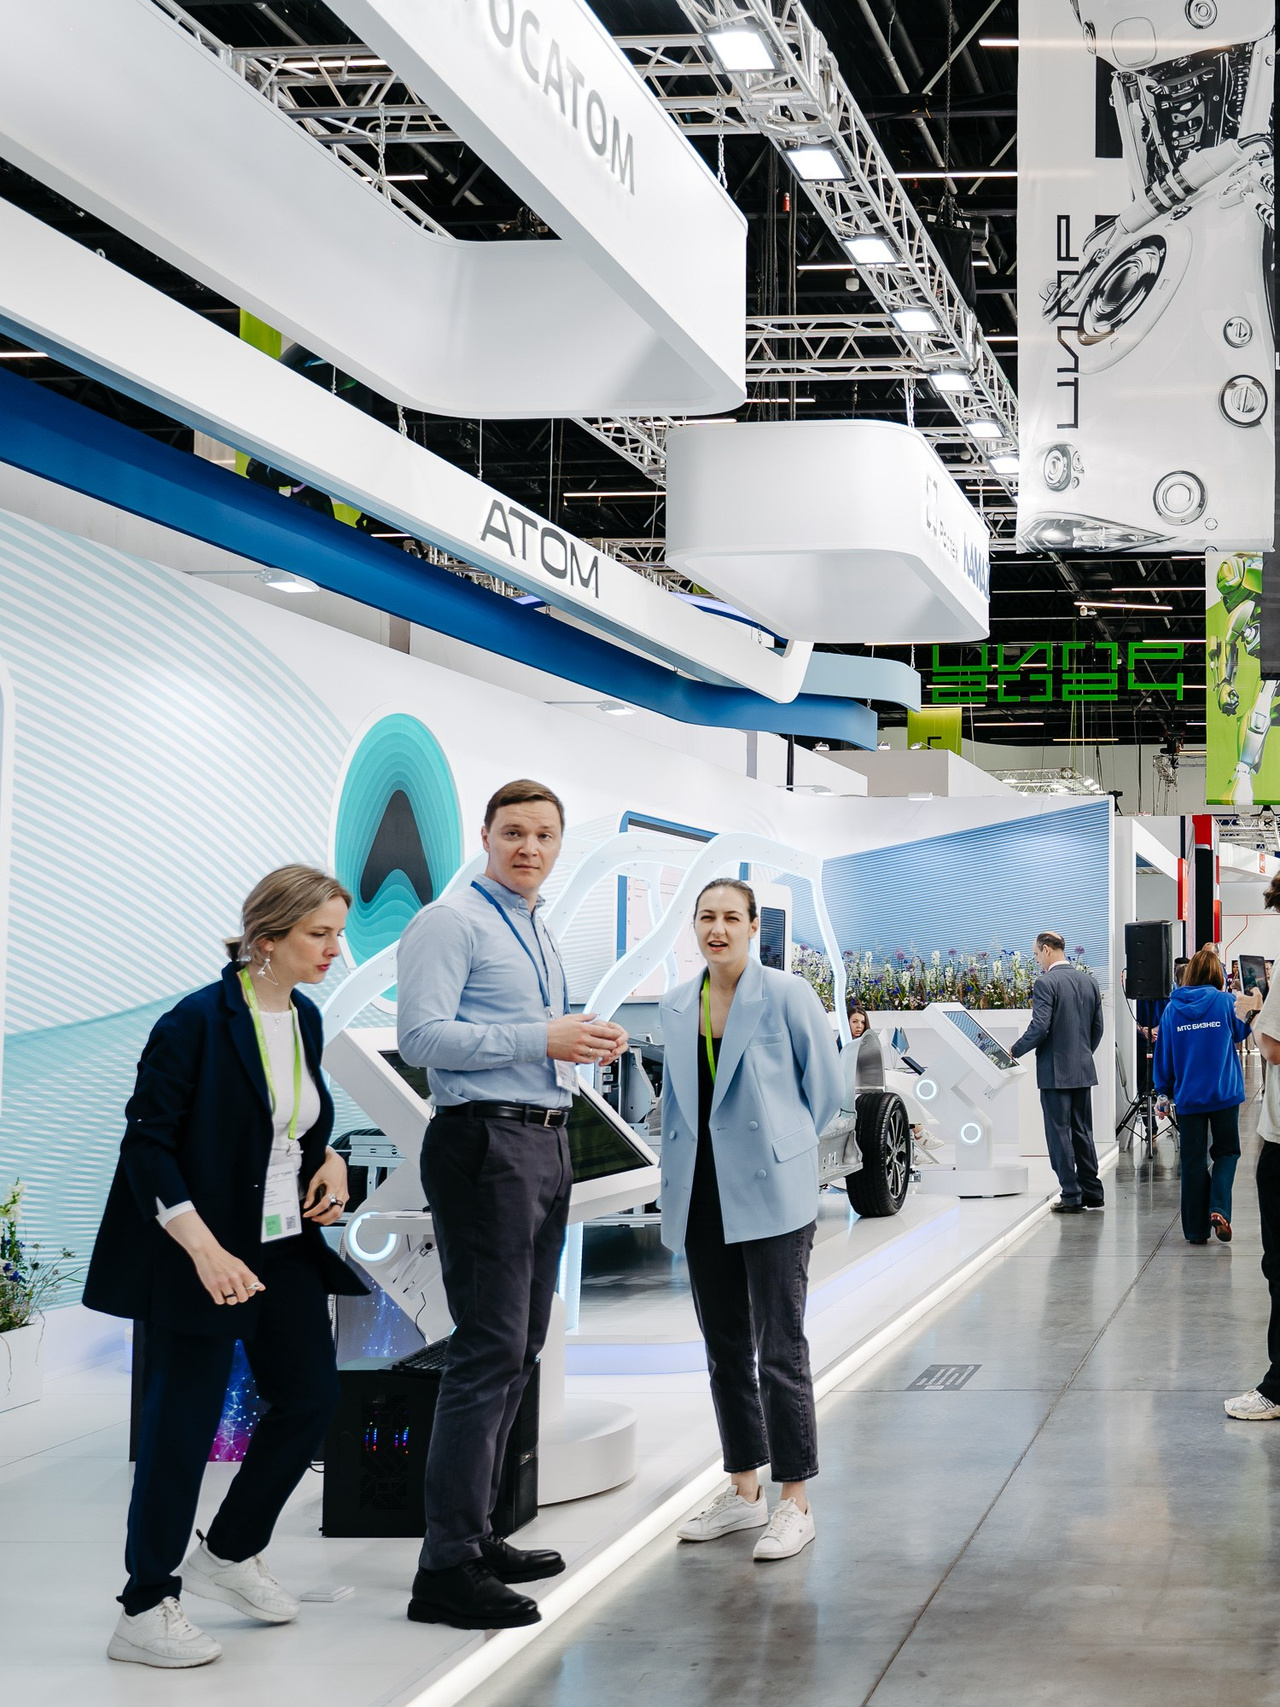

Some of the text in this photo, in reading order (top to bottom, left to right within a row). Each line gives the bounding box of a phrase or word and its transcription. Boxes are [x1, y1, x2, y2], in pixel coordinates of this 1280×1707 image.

[463, 0, 635, 196] ОСАТОМ
[1056, 214, 1080, 429] ЦИПР
[932, 642, 1184, 672] ЦИПР
[932, 672, 1184, 703] 2024
[1192, 1021, 1221, 1030] БИЗНЕС
